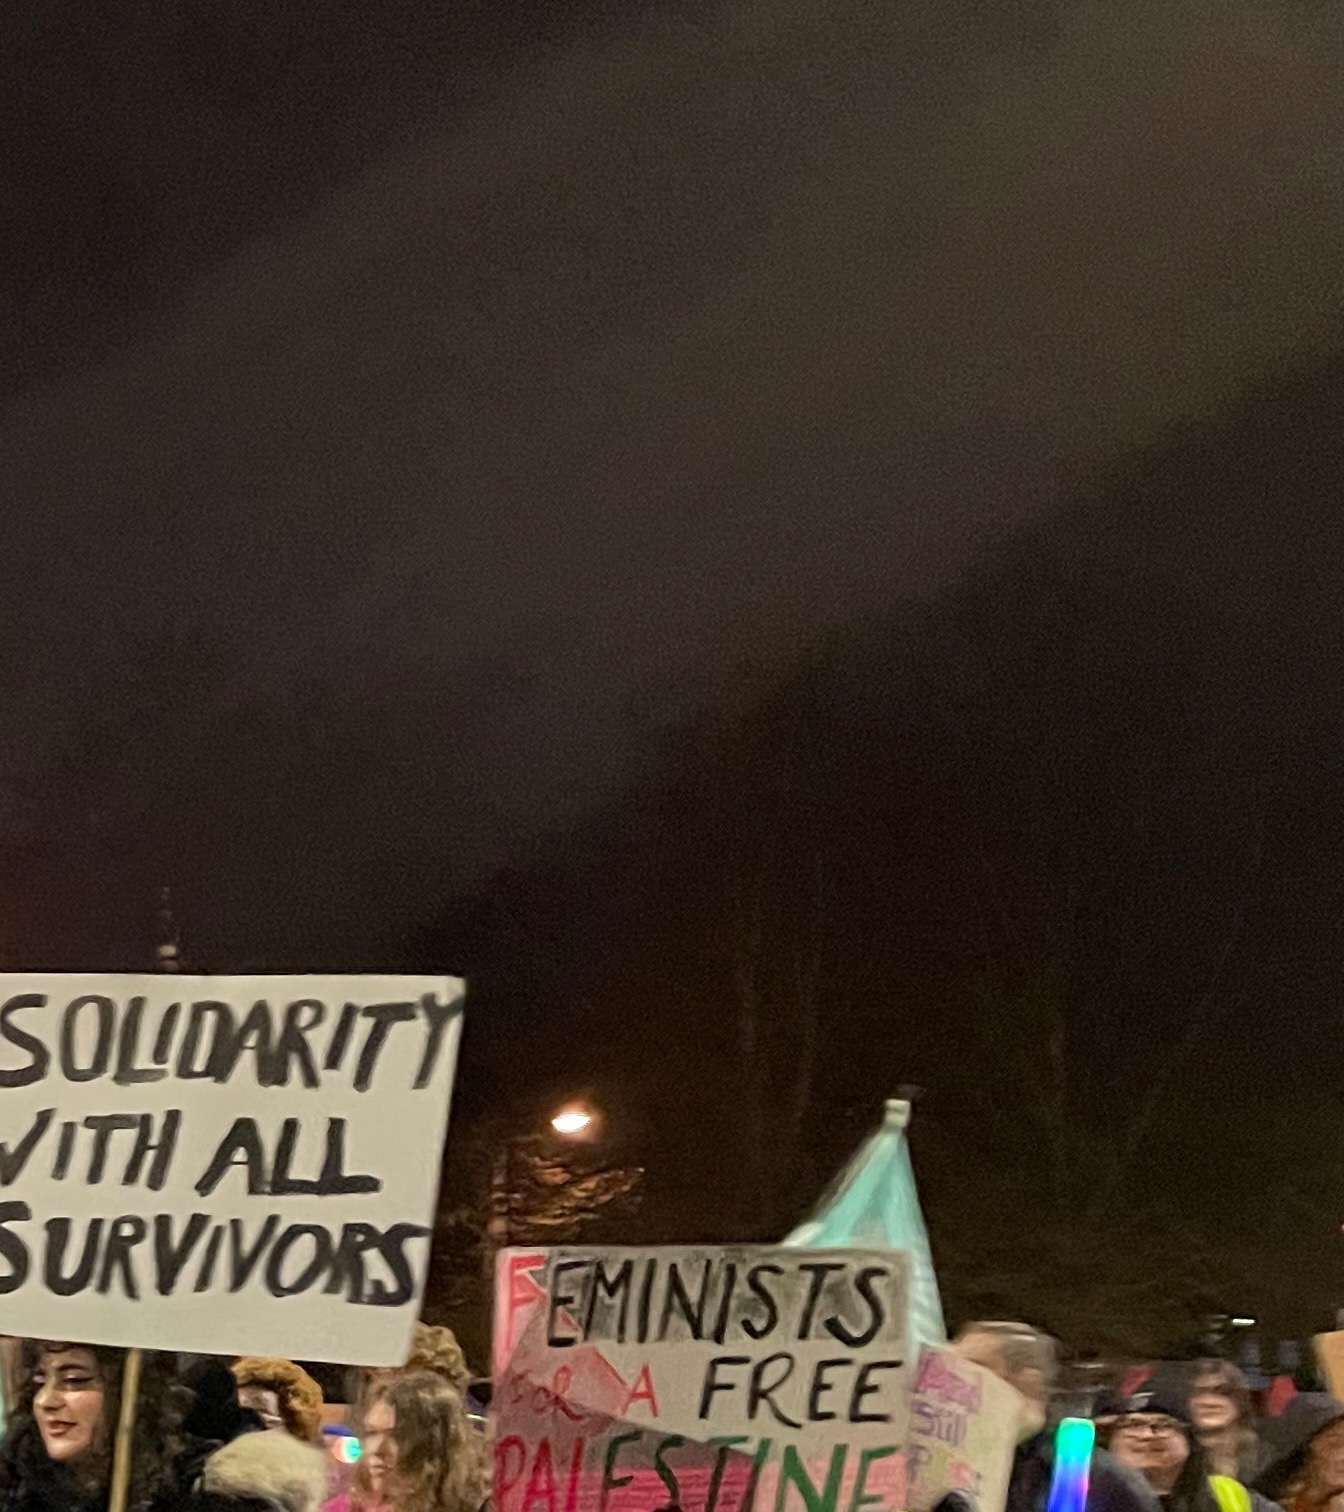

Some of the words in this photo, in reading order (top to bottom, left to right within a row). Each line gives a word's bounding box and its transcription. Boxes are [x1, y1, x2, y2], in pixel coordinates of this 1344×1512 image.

[195, 1117, 381, 1197] ALL
[506, 1254, 893, 1356] FEMINISTS
[620, 1363, 660, 1419] A
[698, 1352, 902, 1429] FREE
